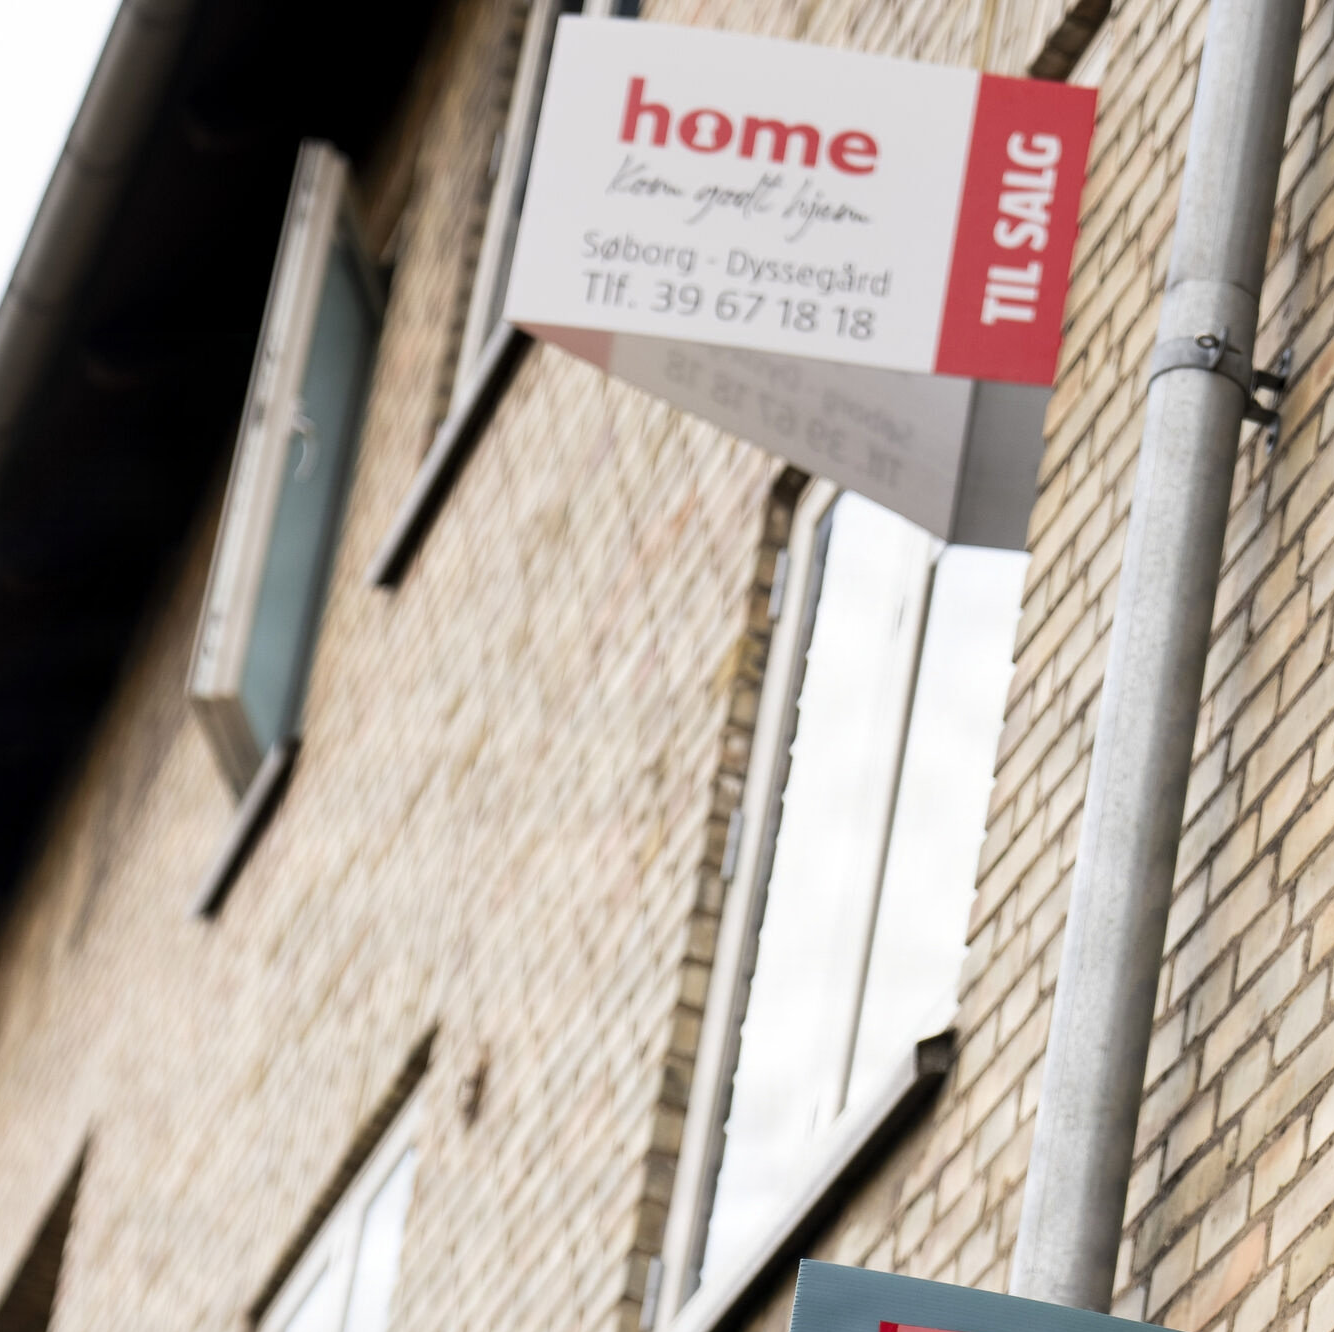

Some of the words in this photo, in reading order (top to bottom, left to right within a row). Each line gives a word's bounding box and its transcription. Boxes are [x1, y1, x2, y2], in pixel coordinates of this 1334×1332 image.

[619, 75, 879, 175] home
[605, 153, 684, 197] Kom
[781, 178, 875, 244] hjem
[993, 131, 1063, 252] SALG
[582, 229, 698, 276] Søborg
[725, 247, 894, 297] Dyssegård
[980, 259, 1044, 326] TIL
[582, 270, 637, 309] Tlf.
[650, 280, 704, 316] 39
[714, 290, 765, 324] 67
[777, 297, 818, 333] 18
[833, 304, 877, 342] 18
